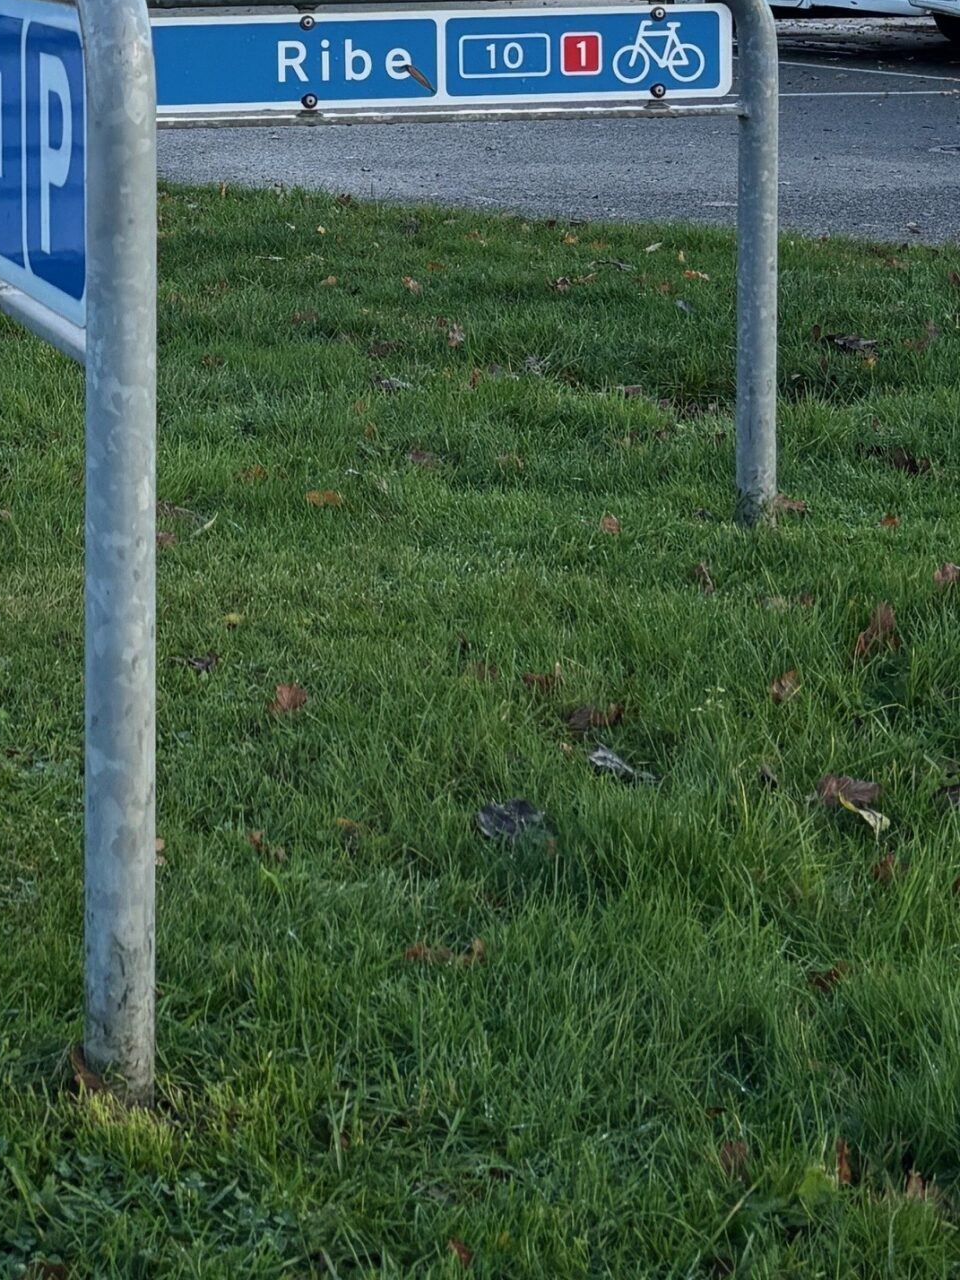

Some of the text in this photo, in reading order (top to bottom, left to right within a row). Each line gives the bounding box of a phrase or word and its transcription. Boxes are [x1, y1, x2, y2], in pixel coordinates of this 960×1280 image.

[278, 39, 587, 83] Ribe 10 1
[40, 52, 72, 255] P
